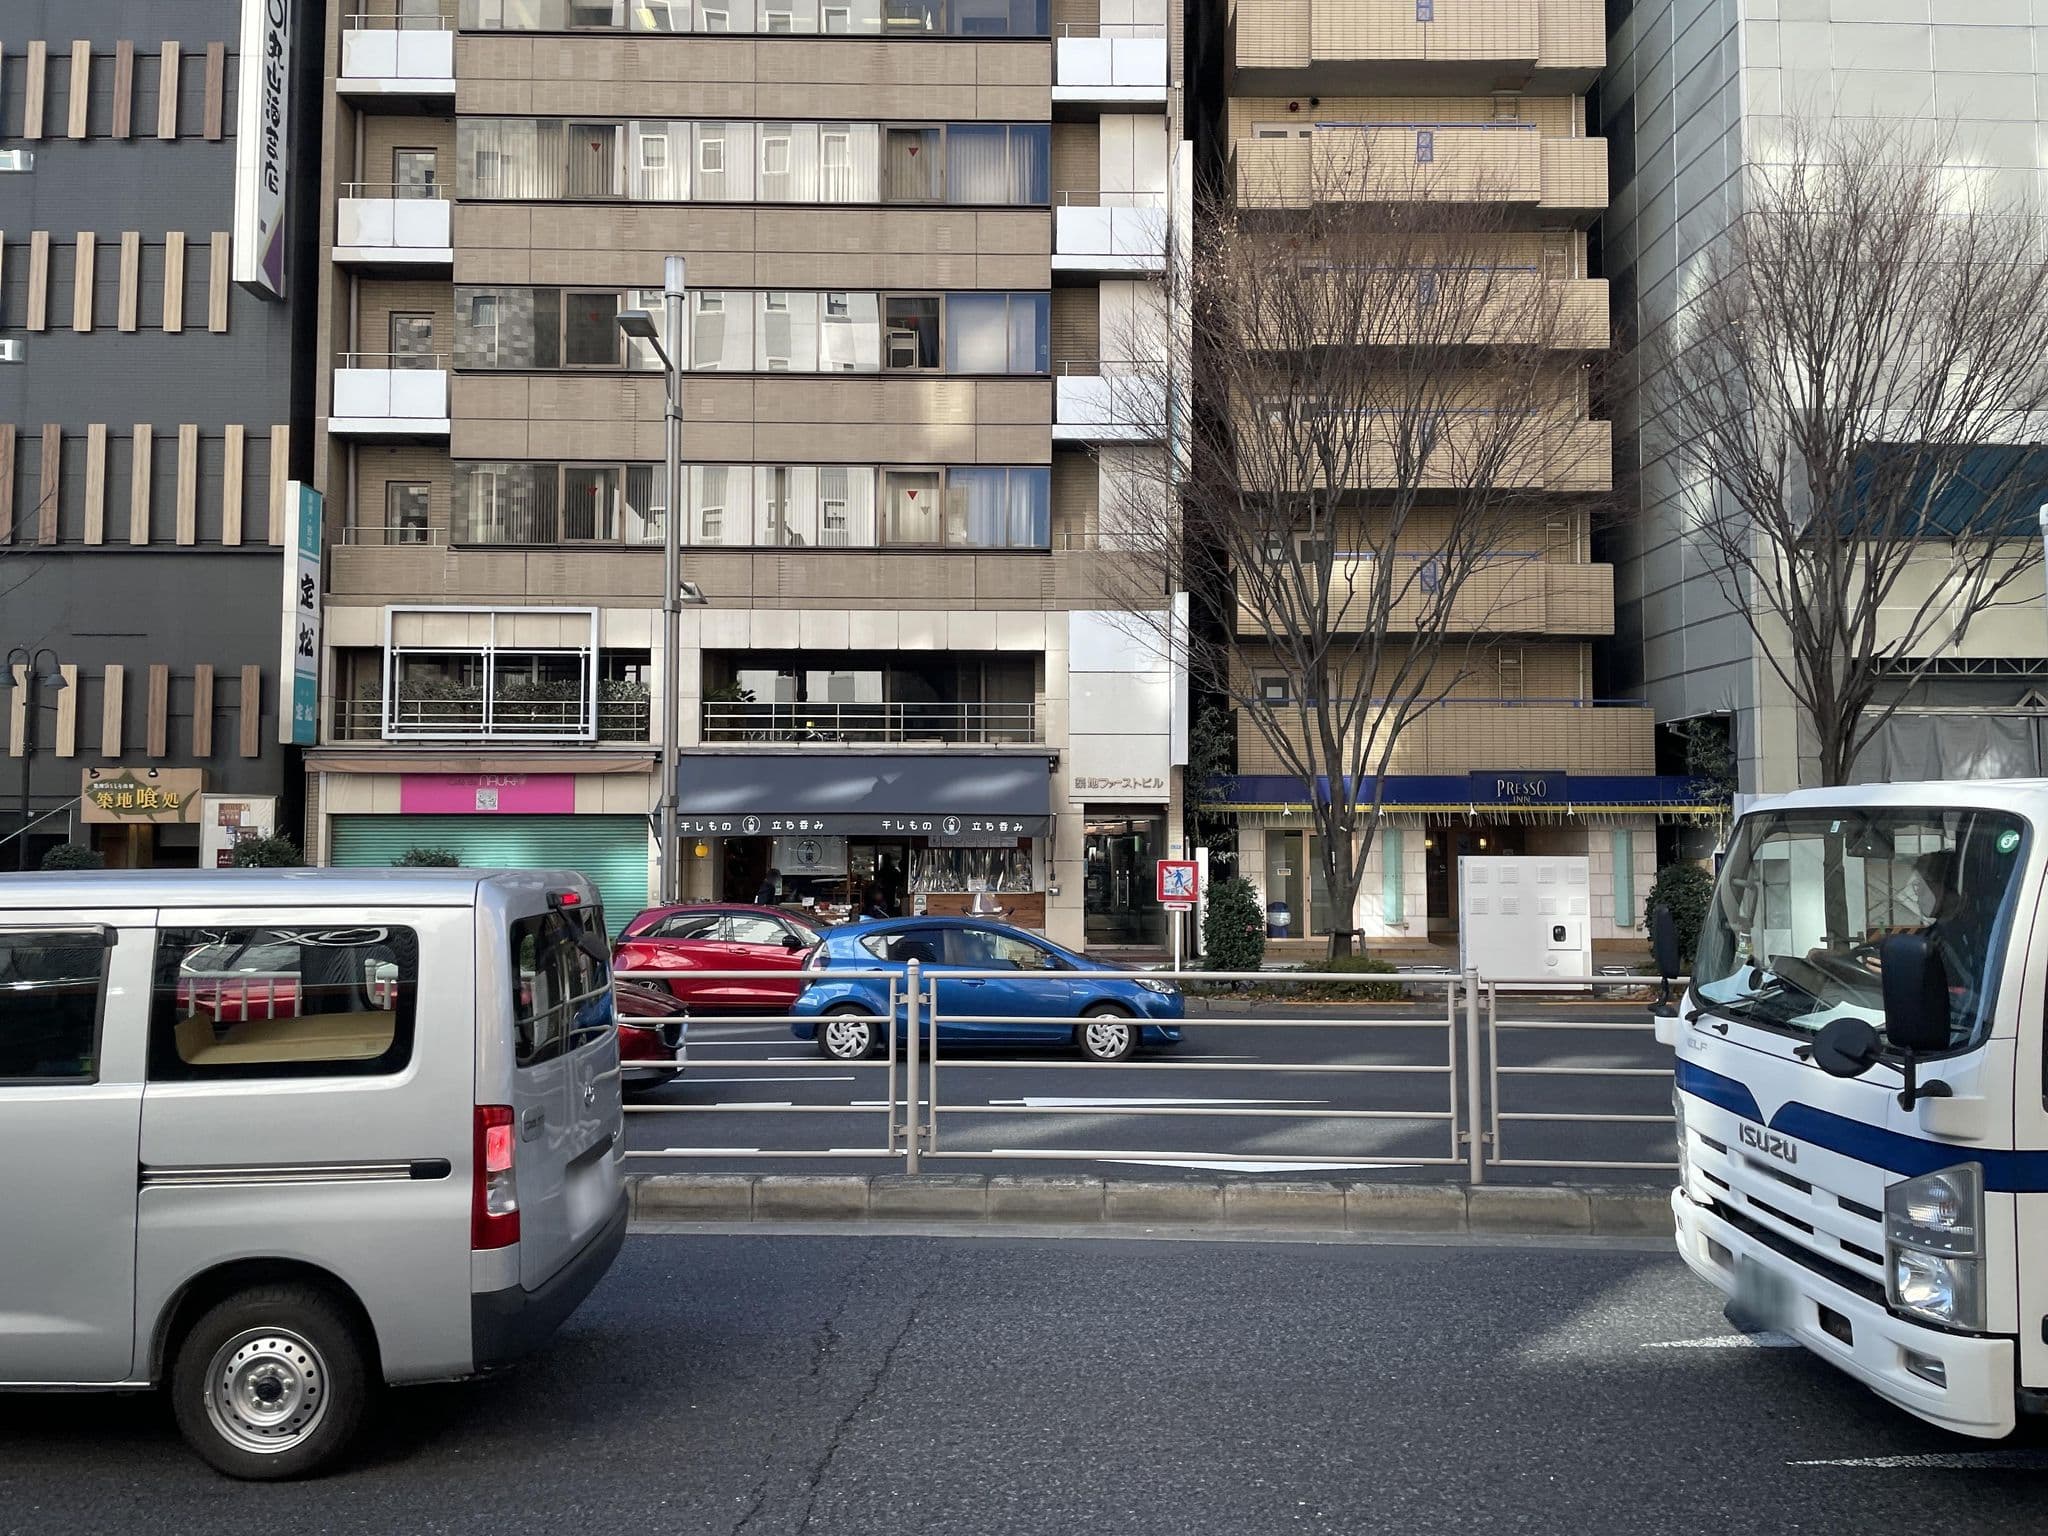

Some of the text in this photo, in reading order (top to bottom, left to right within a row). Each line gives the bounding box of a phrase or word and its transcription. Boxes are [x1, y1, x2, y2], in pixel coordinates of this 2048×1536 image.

[1075, 776, 1164, 789] 築地ファーストビル
[1497, 779, 1547, 798] PRESSO
[97, 787, 180, 809] 築地喰処
[1513, 795, 1531, 803] INN
[681, 821, 732, 832] 干しもの
[771, 820, 824, 831] 立ち呑み
[882, 820, 932, 830] 干しもの
[971, 821, 1024, 832] 立ち呑み
[1687, 1038, 1708, 1051] ELF
[1739, 1122, 1797, 1164] ISUZU
